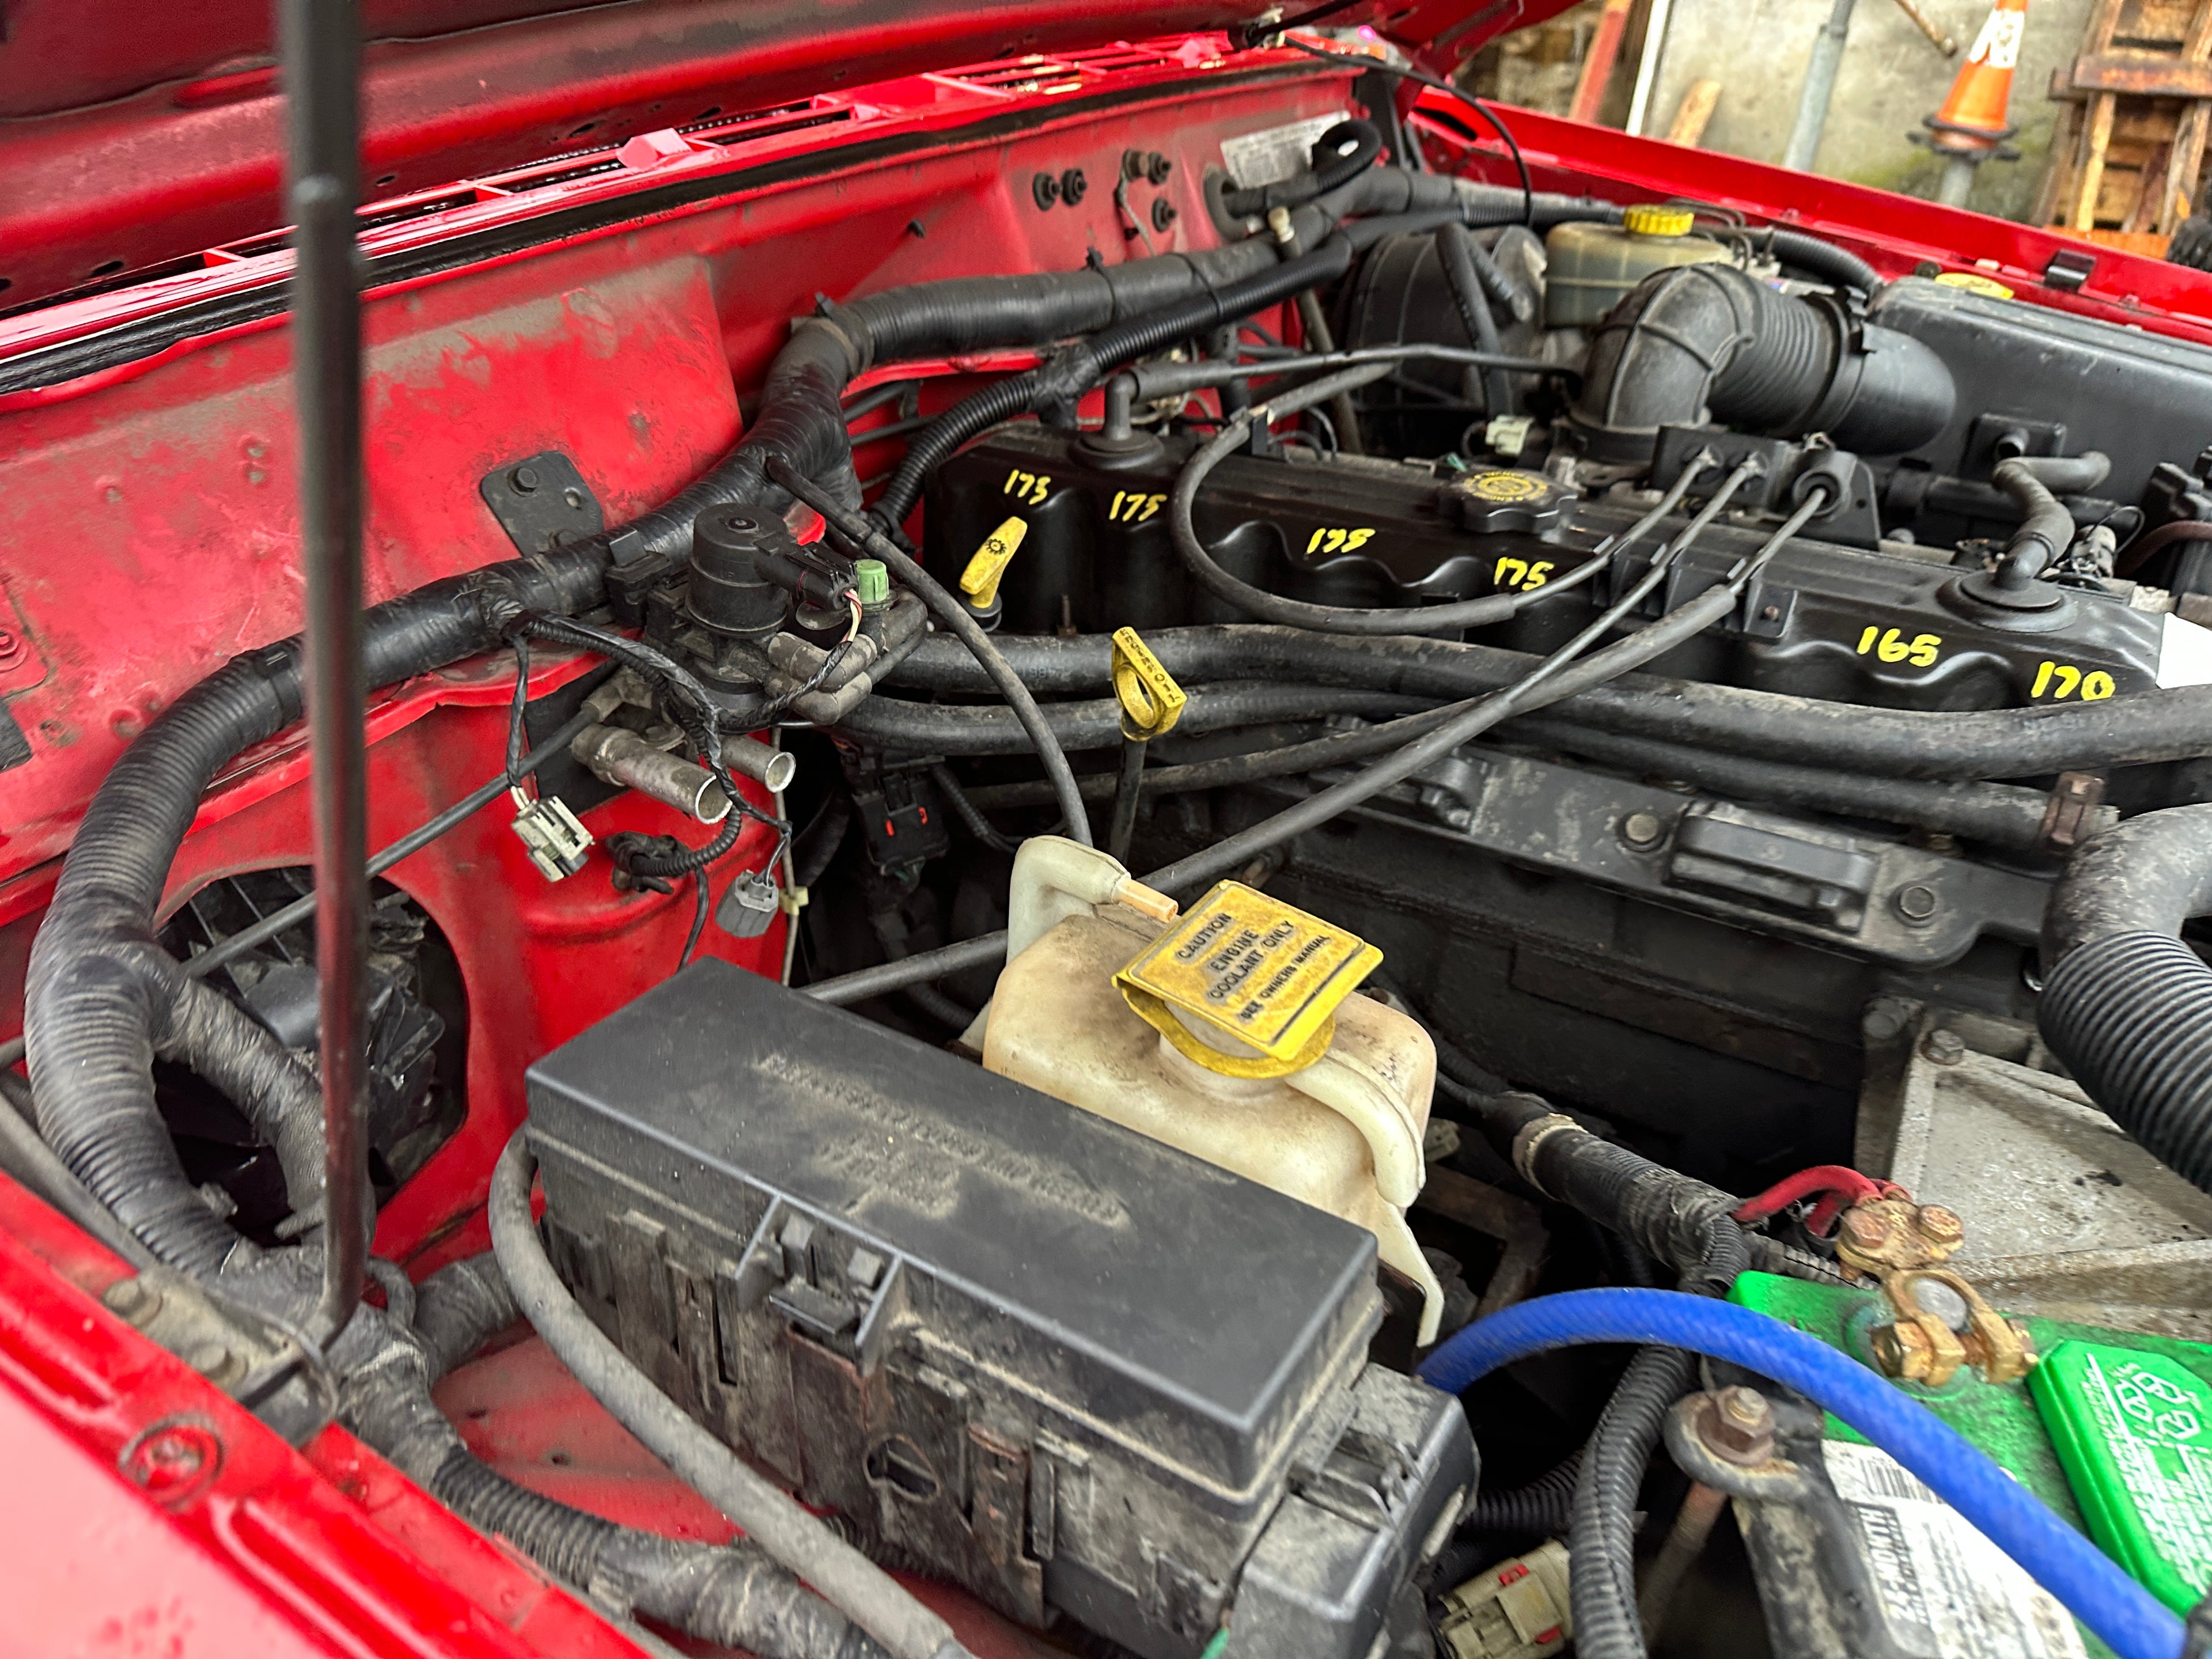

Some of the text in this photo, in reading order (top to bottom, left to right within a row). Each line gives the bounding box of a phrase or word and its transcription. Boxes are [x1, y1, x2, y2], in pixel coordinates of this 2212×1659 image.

[1109, 491, 1167, 521] 175
[1306, 528, 1376, 554] 175
[1494, 556, 1554, 592] 175
[1857, 626, 1942, 667] 165
[1154, 673, 1181, 703] OIL
[2031, 661, 2116, 701] 170
[1177, 912, 1233, 959] CAUTION
[1210, 929, 1260, 972] ENGINE
[1209, 920, 1295, 999] COOLANT ONLY
[1240, 934, 1331, 1020] SEE OWNERS MANUAL
